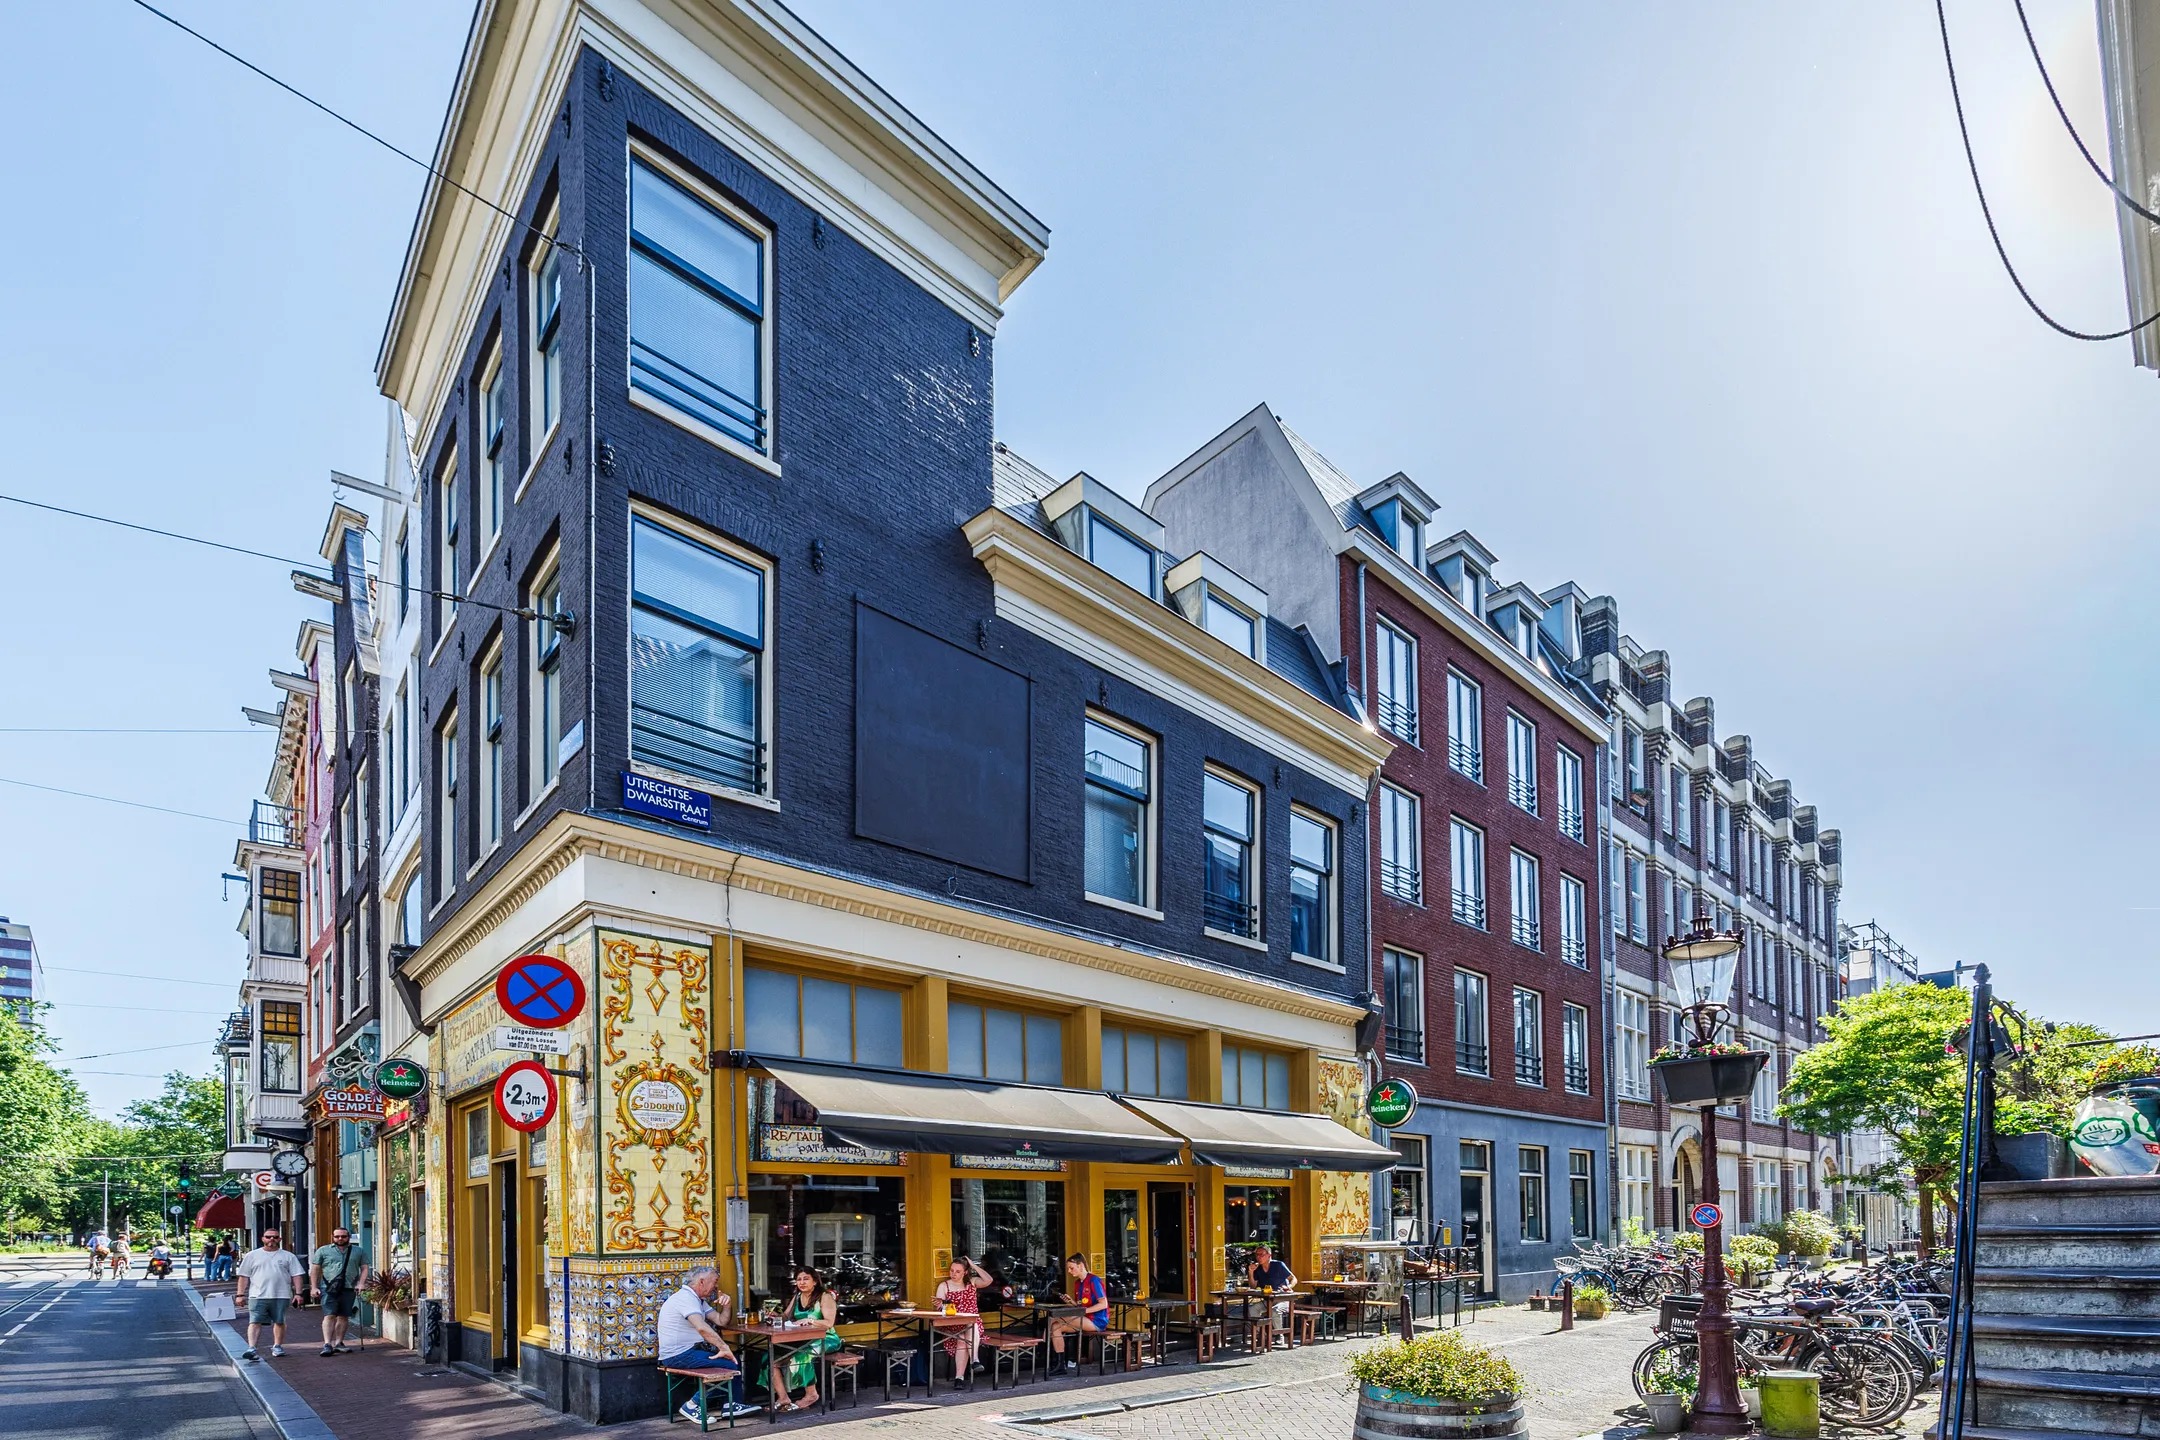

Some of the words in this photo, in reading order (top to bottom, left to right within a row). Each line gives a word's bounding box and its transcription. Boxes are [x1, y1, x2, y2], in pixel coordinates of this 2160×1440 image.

[627, 775, 693, 801] UTRECHTSE-
[627, 788, 708, 817] DWARSSTRAAT
[682, 814, 709, 826] Centrum
[511, 1027, 554, 1037] Uitgezonderd
[381, 1079, 421, 1087] Heineken
[324, 1089, 383, 1103] GOLDEN
[510, 1084, 541, 1107] 2,3m
[326, 1101, 384, 1113] TEMPLE
[1371, 1103, 1407, 1113] Heineken
[797, 1143, 829, 1155] PATA
[832, 1146, 867, 1158] NEGRA
